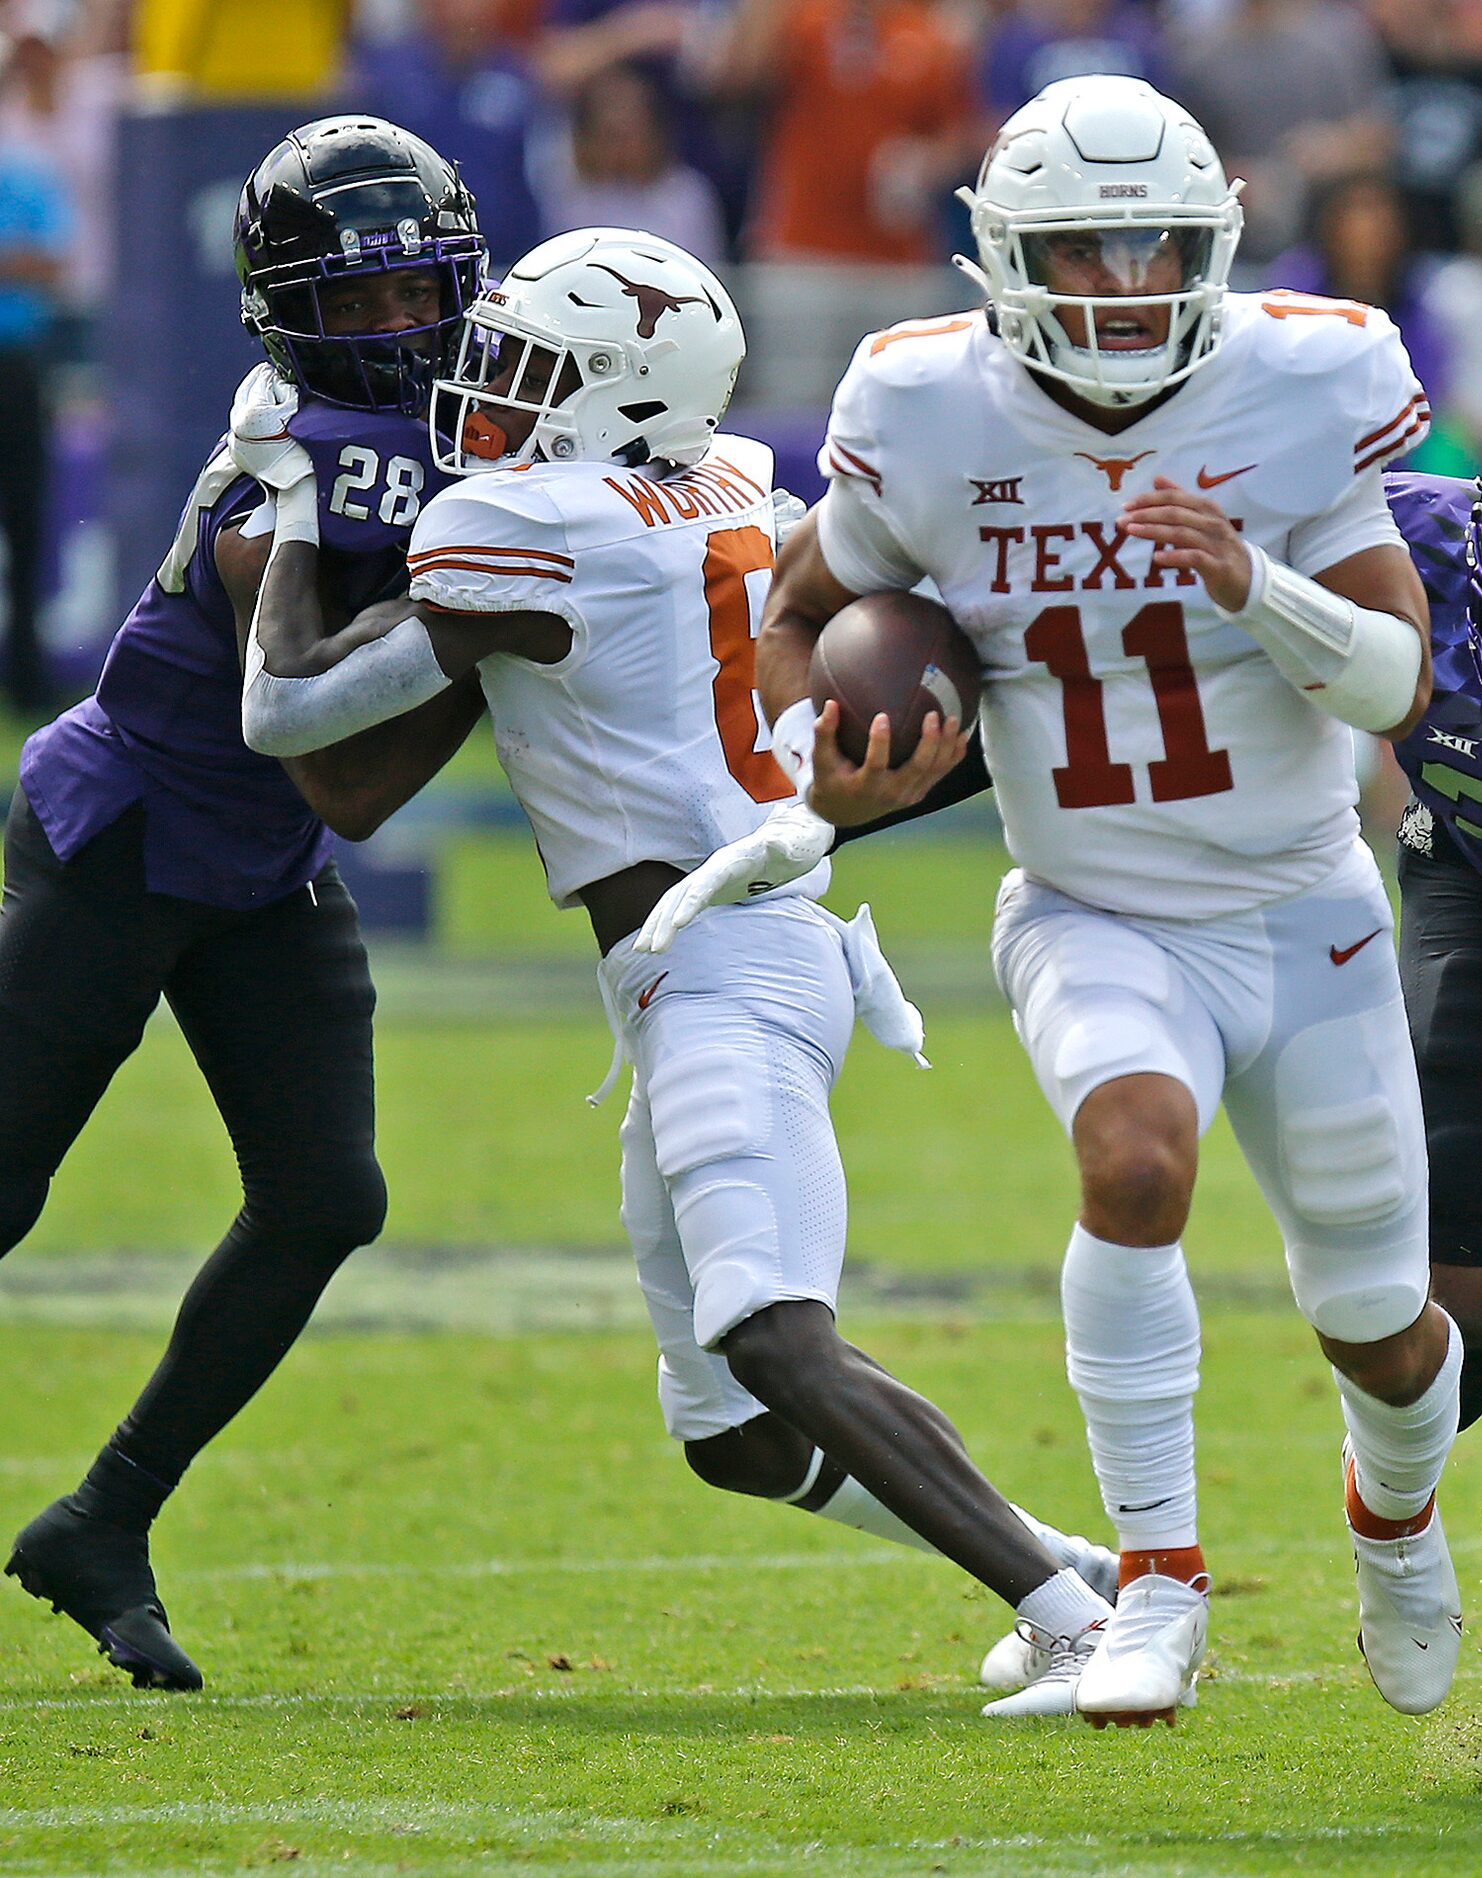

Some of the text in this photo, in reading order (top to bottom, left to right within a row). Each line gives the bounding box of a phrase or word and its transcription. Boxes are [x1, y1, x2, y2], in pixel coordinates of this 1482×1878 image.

[1100, 184, 1148, 198] HORNS
[329, 444, 425, 527] 28
[967, 475, 1026, 506] XII
[978, 517, 1244, 594] TEXA
[1022, 600, 1235, 809] 11
[1425, 724, 1481, 761] XII
